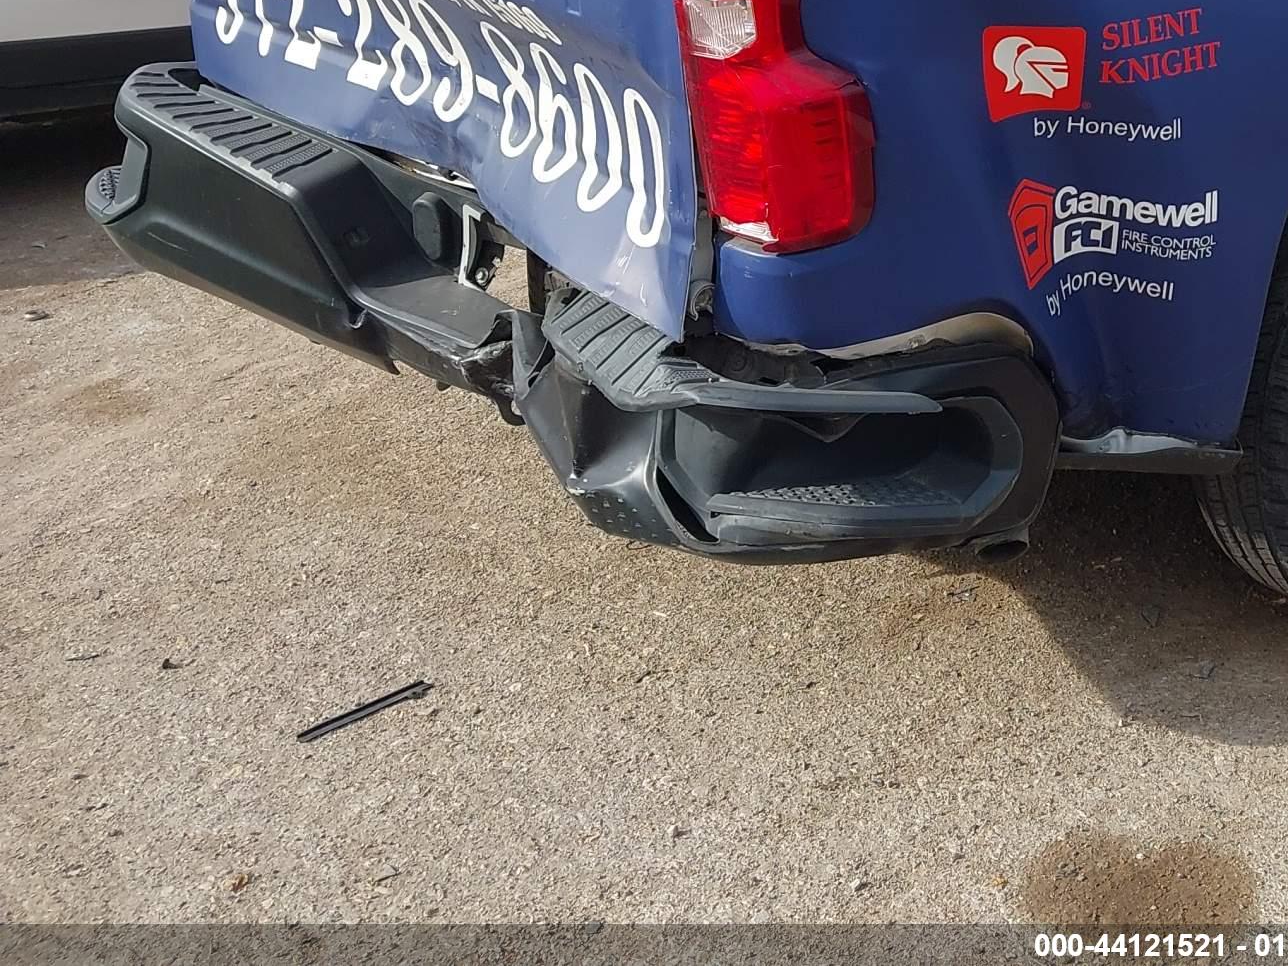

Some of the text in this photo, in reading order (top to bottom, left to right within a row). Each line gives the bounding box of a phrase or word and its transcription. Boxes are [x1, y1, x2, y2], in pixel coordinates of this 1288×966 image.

[1101, 7, 1203, 52] SILENT
[1098, 40, 1221, 85] KNIGHT
[1033, 115, 1182, 142] by Honeywell
[1054, 185, 1219, 228] Gamewell
[1060, 219, 1217, 256] FCI FIRE CONTROL
[1121, 239, 1213, 261] INSTRUMENTS
[1045, 270, 1175, 317] by Honeywell
